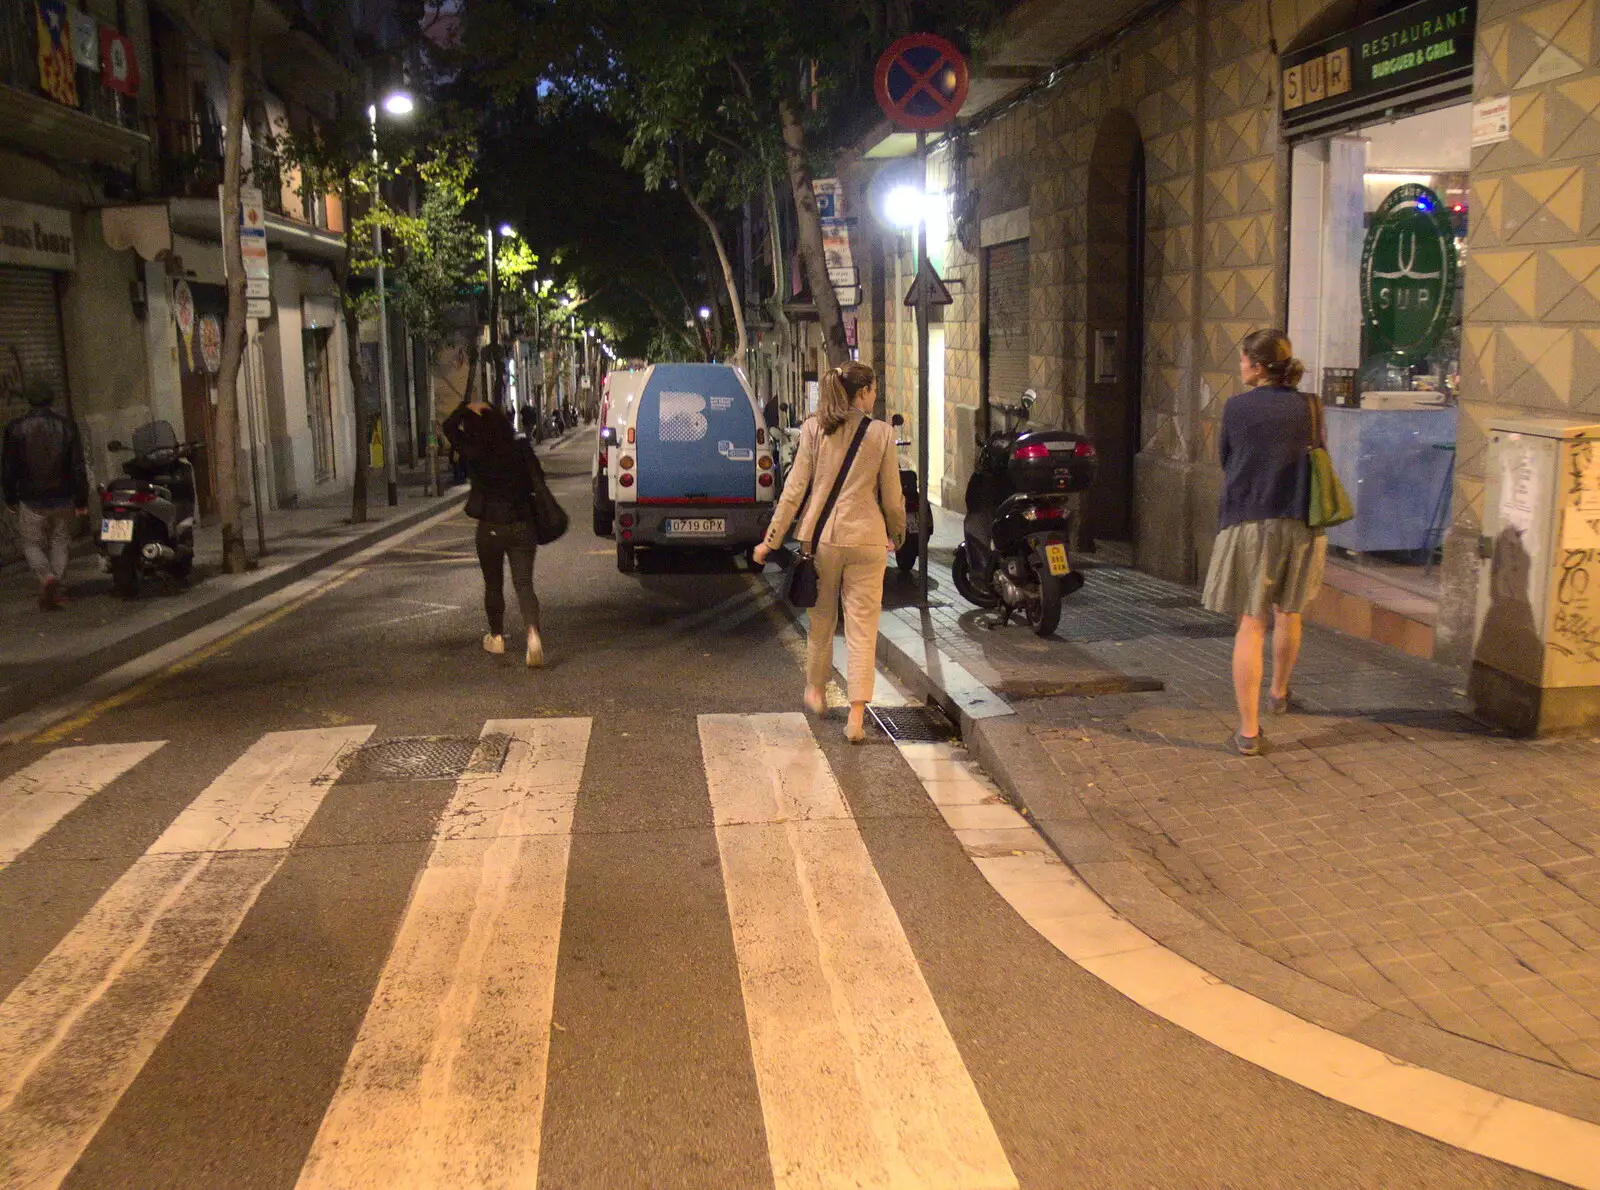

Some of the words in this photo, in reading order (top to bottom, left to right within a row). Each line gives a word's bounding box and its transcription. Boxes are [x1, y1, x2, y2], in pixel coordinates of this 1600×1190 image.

[1361, 6, 1468, 60] RESTAURANT
[1287, 54, 1344, 100] SUR
[1371, 52, 1416, 80] BURGUER
[1415, 49, 1425, 66] &
[1425, 38, 1456, 62] GRILL
[1379, 286, 1430, 310] SUR
[673, 520, 700, 531] 0719
[702, 520, 723, 531] GPX
